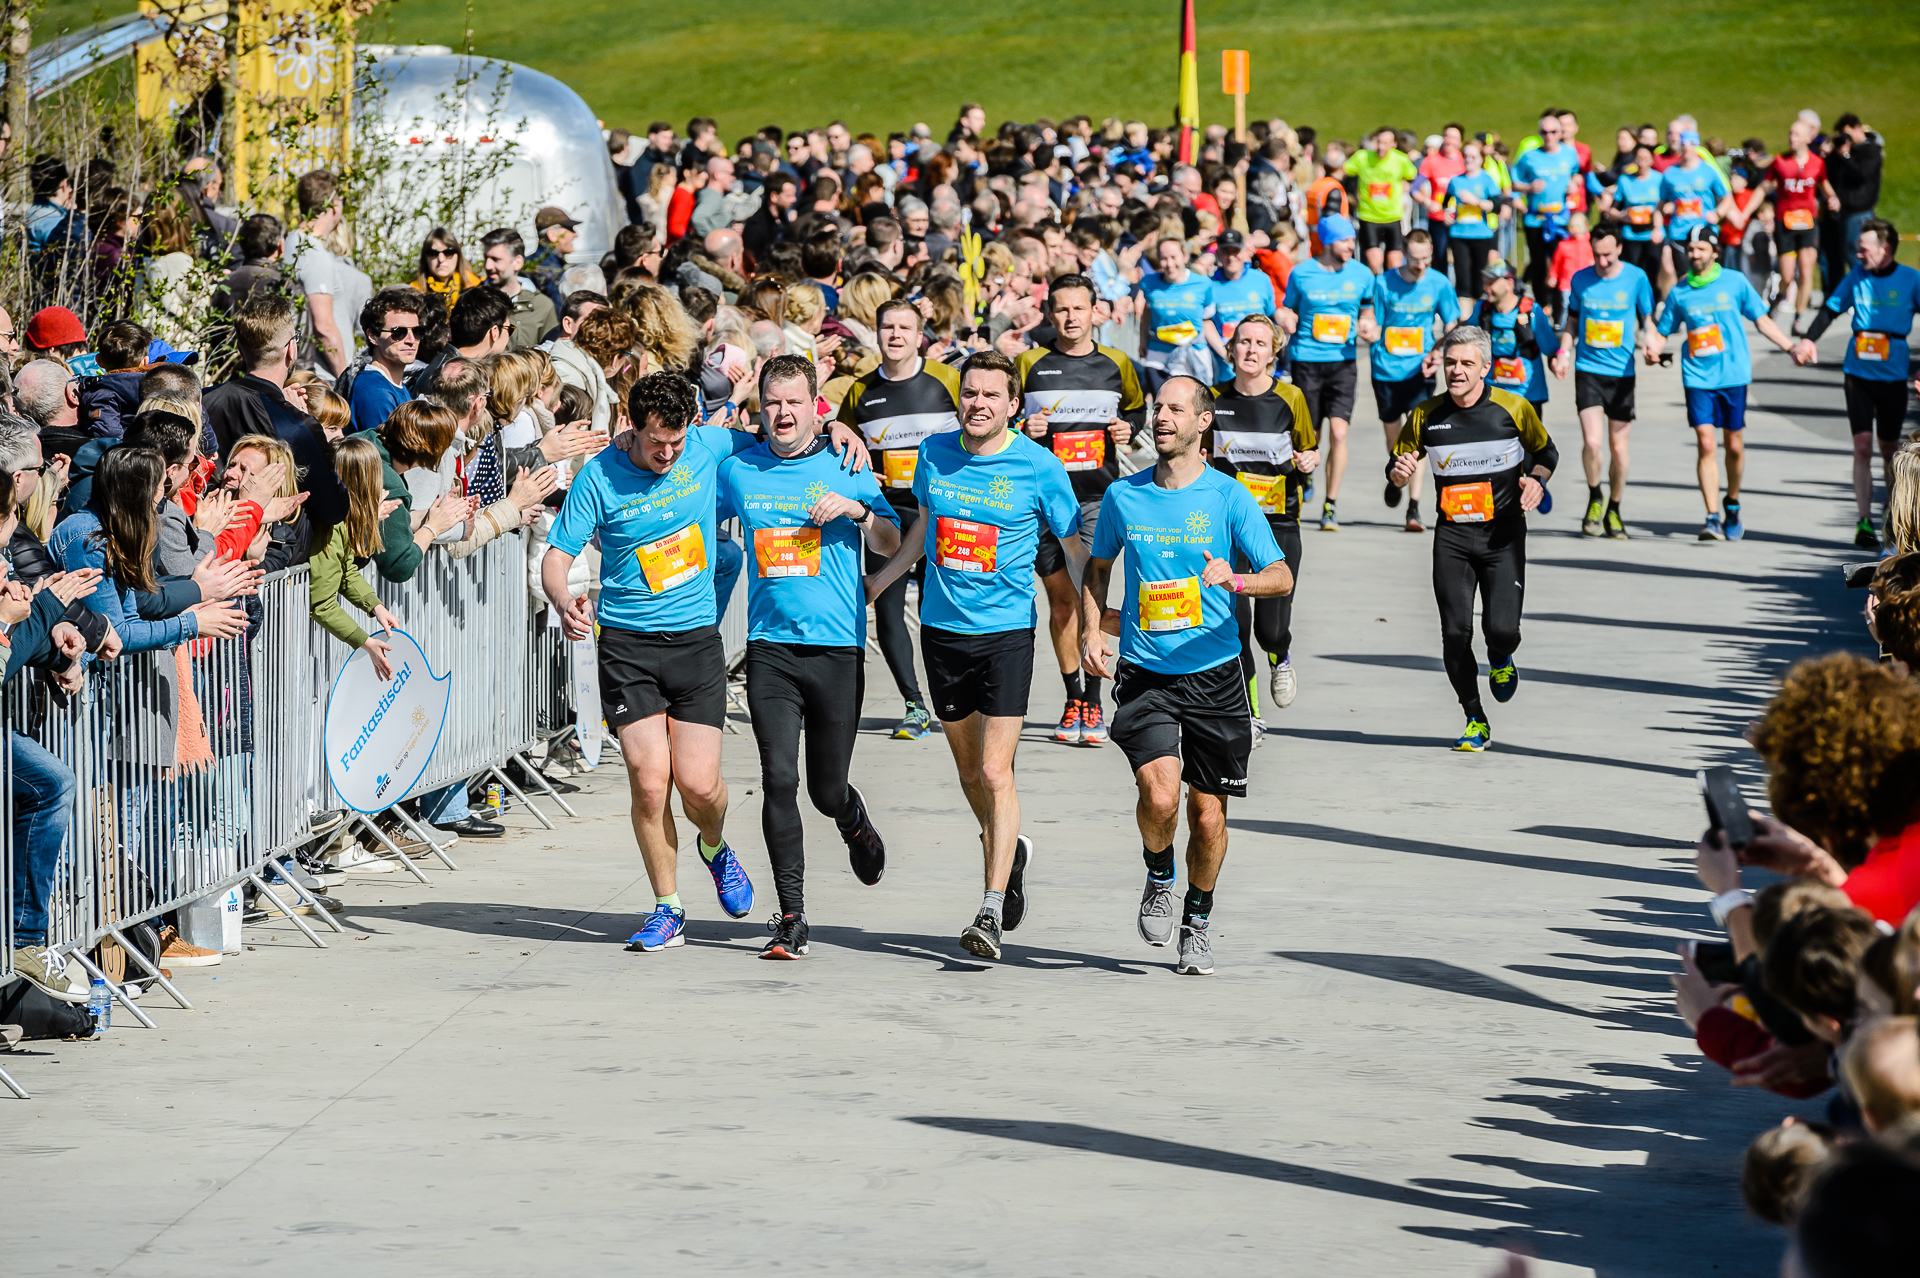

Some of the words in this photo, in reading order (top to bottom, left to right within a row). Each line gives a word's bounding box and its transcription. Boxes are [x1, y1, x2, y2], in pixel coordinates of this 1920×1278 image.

[1053, 406, 1097, 414] Valckenier
[882, 430, 924, 441] Valckenier
[1446, 459, 1489, 468] Valckenier
[623, 507, 640, 519] Kom
[641, 503, 652, 514] op
[652, 494, 676, 508] tegen
[675, 482, 702, 499] Kanker
[928, 484, 943, 496] Kom
[944, 490, 955, 500] op
[956, 491, 981, 504] tegen
[983, 496, 1014, 511] Kanker
[744, 500, 760, 510] Kom
[762, 502, 772, 511] op
[774, 501, 799, 512] tegen
[778, 517, 792, 525] 2019
[954, 532, 977, 543] TOBIAS
[1126, 531, 1142, 541] Kom
[1143, 534, 1154, 544] op
[1156, 533, 1181, 545] tegen
[1183, 534, 1214, 544] Kanker
[773, 539, 801, 548] WOUTER
[664, 544, 681, 558] BERT
[957, 546, 970, 556] 248
[1161, 550, 1175, 558] 2019
[780, 553, 794, 561] 248
[671, 558, 685, 570] 248
[1148, 591, 1185, 602] ALEXANDER
[1161, 606, 1175, 615] 248
[340, 661, 412, 773] Fantastisch!
[376, 776, 392, 799] KBC
